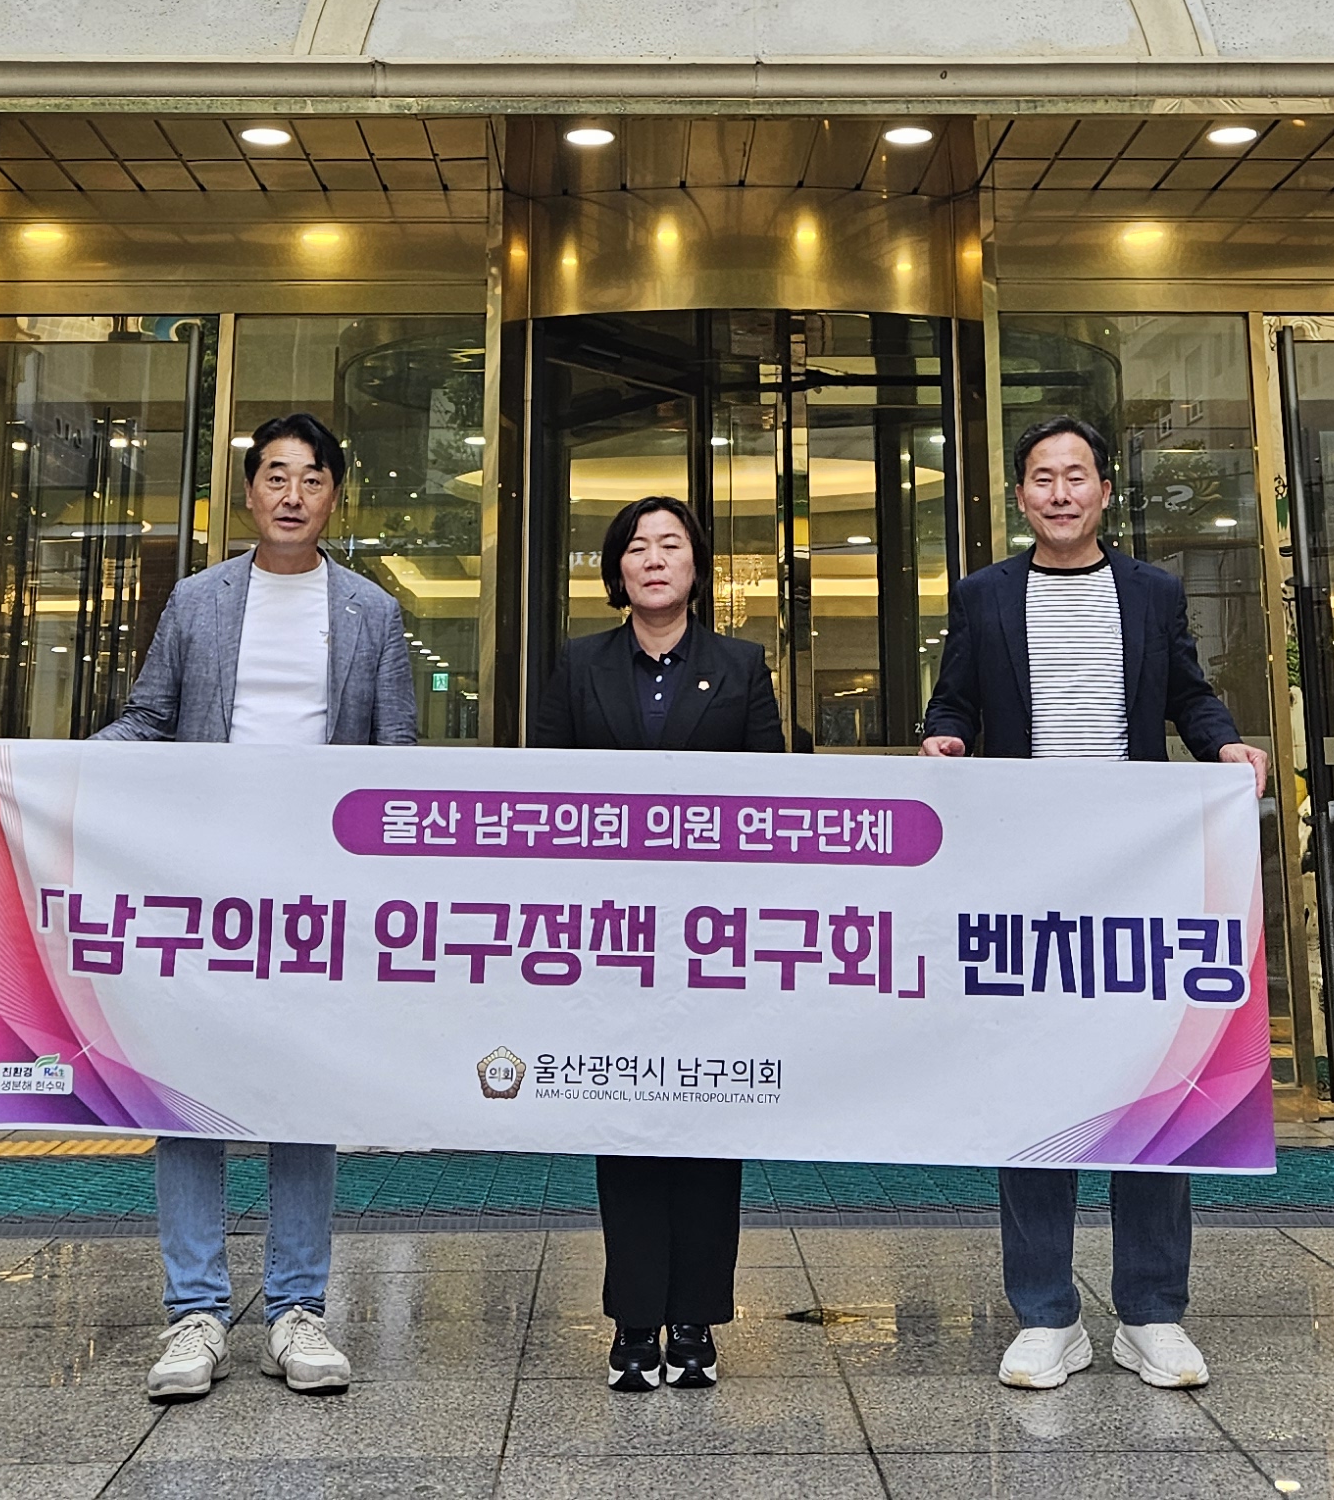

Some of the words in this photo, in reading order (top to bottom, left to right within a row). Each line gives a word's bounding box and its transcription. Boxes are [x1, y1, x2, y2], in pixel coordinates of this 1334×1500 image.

[380, 799, 462, 846] 울산
[474, 801, 630, 849] 남구의회
[644, 804, 721, 851] 의원
[736, 806, 894, 855] 연구단체
[39, 887, 348, 982] 「남구의회
[373, 897, 657, 988] 인구정책
[683, 904, 927, 1000] 연구회」
[957, 910, 1244, 1004] 벤치마킹
[1, 1066, 33, 1078] 친환경
[488, 1066, 515, 1083] 의회
[533, 1053, 665, 1087] 울산광역시
[677, 1056, 782, 1090] 남구의회
[534, 1088, 580, 1100] NAM-GU
[582, 1089, 632, 1103] COUNCIL,
[634, 1090, 670, 1102] ULSAN
[672, 1091, 754, 1104] METROPOLITAN
[756, 1093, 781, 1104] CITY
